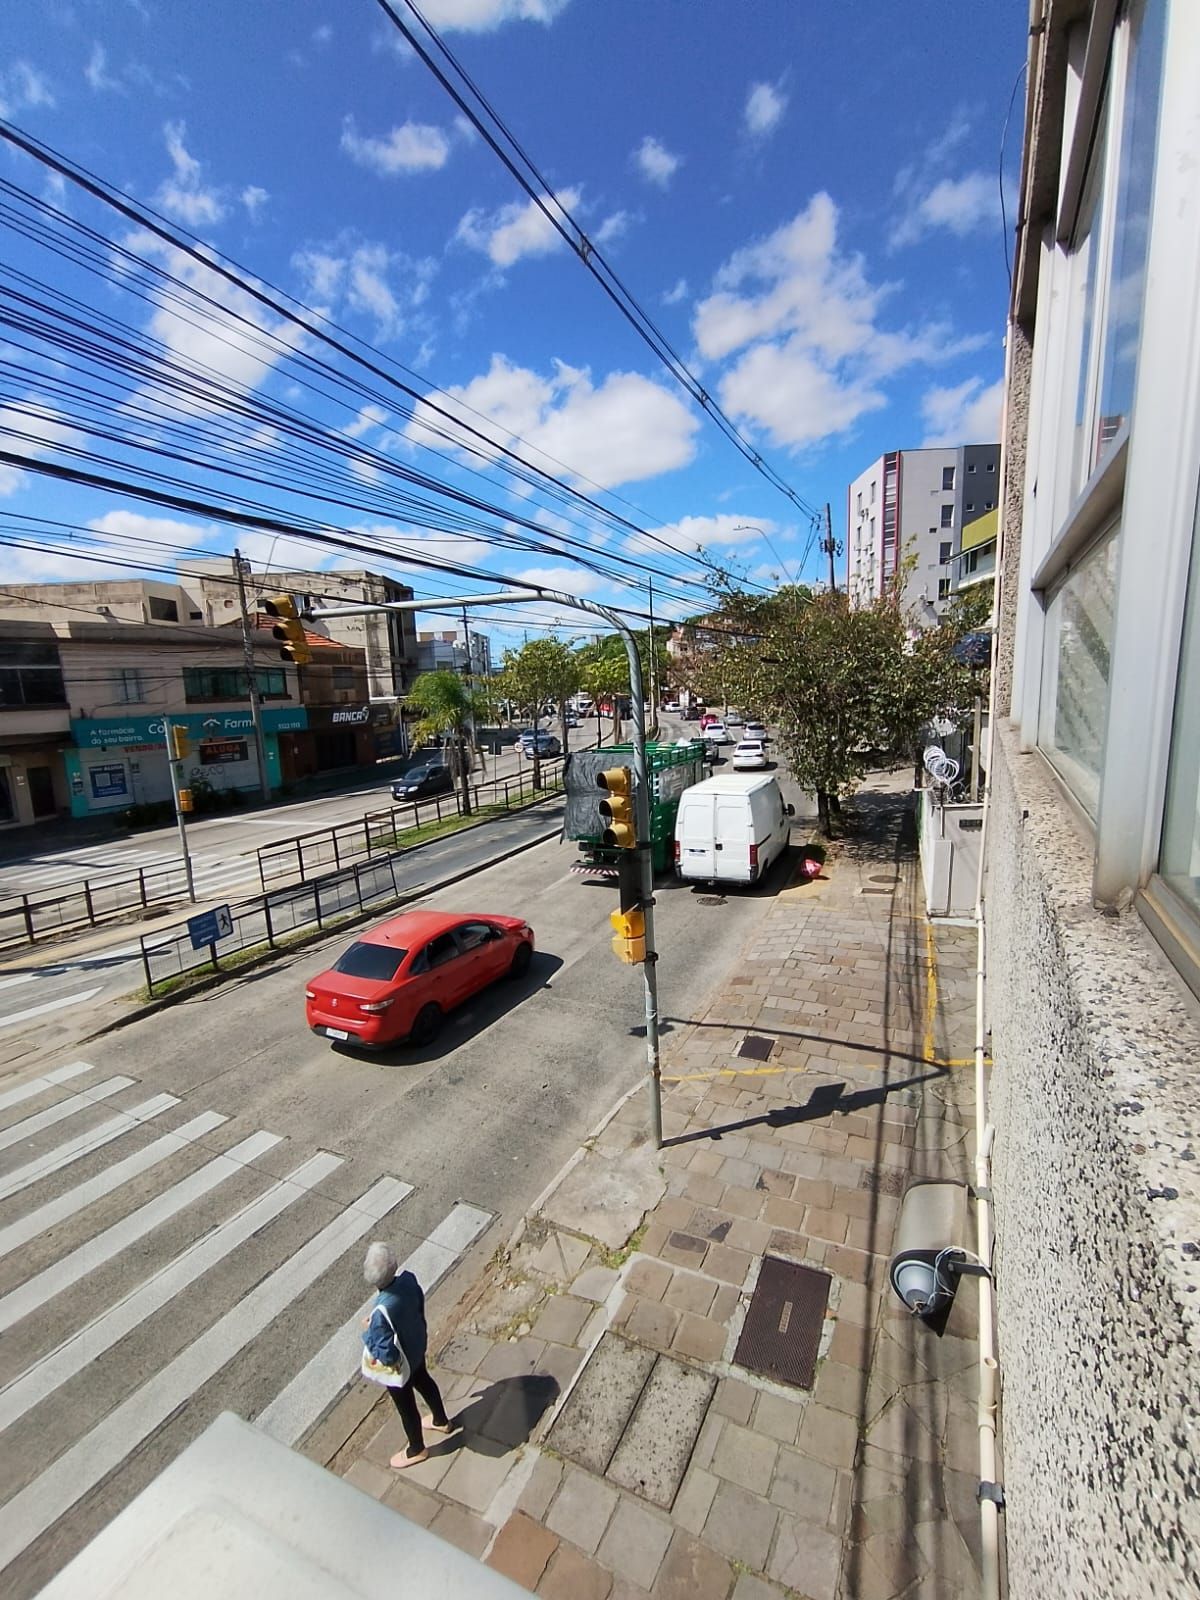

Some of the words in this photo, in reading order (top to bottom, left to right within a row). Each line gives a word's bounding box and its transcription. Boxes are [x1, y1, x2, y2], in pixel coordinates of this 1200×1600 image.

[332, 711, 363, 723] BANCA
[224, 719, 252, 729] Farm
[91, 737, 102, 745] do
